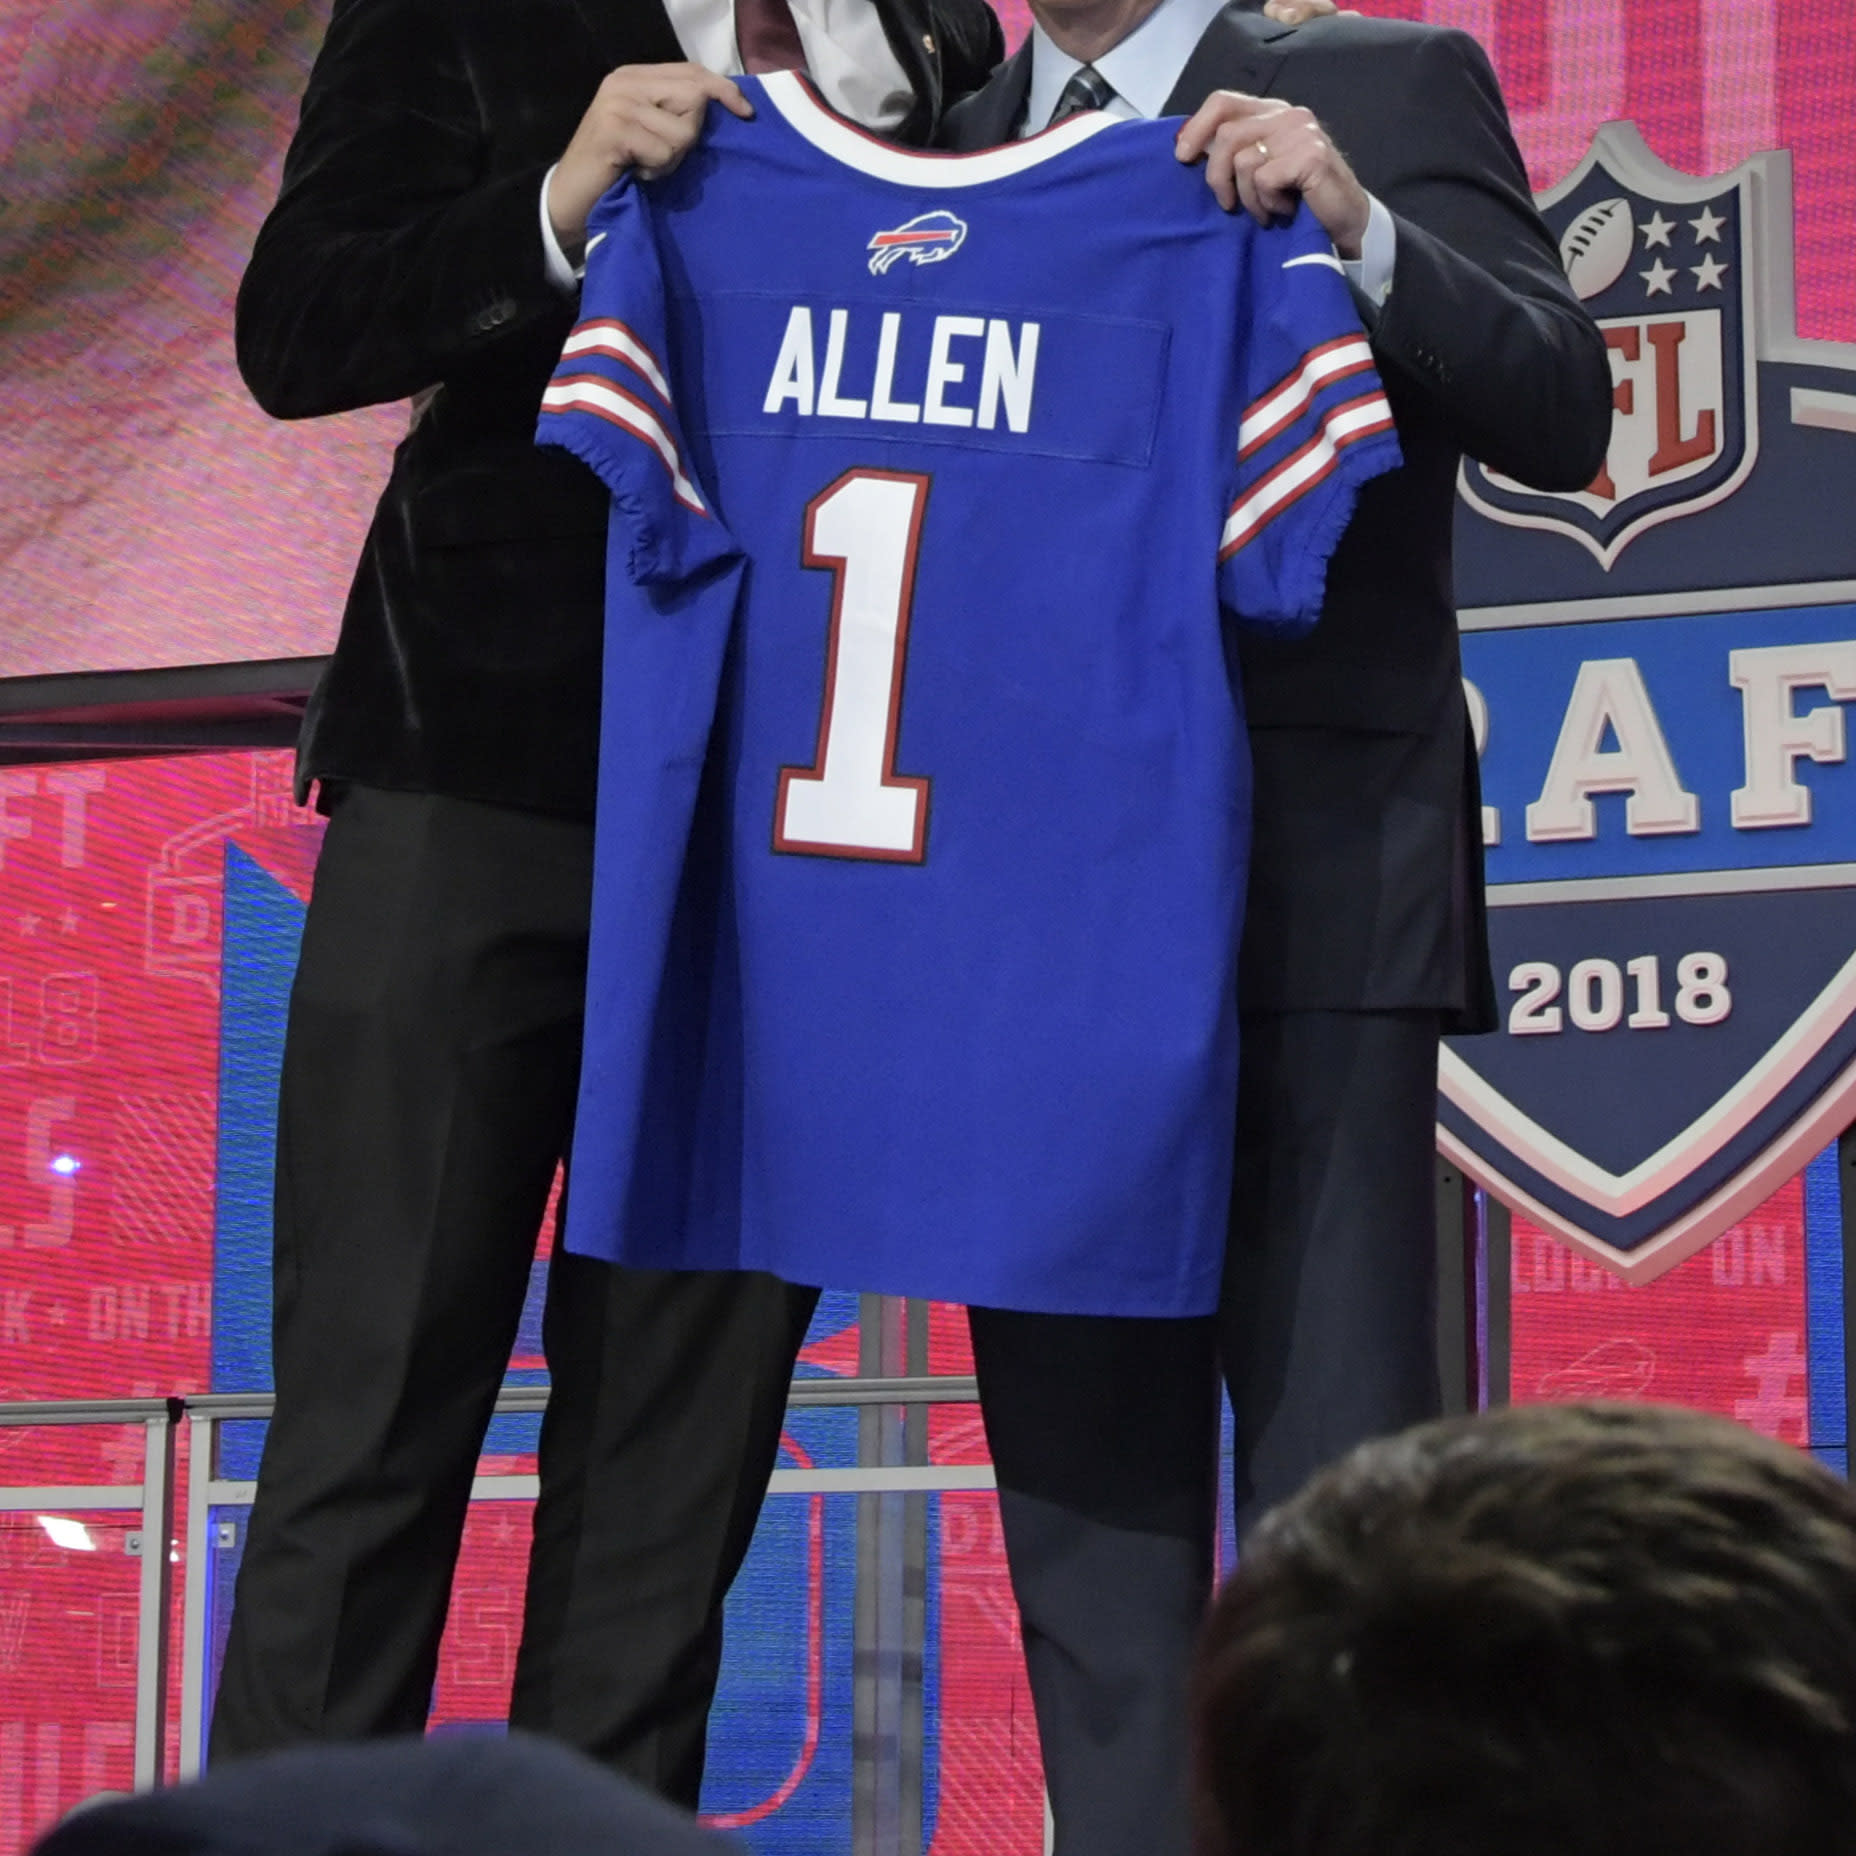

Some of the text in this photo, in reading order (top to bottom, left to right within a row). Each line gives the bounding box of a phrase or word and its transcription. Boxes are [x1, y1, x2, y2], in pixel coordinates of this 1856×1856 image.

[762, 305, 1041, 434] ALLEN
[771, 465, 932, 866] 1
[1507, 951, 1733, 1036] 2018
[1712, 1224, 1787, 1287] ON
[87, 1284, 145, 1342] ON
